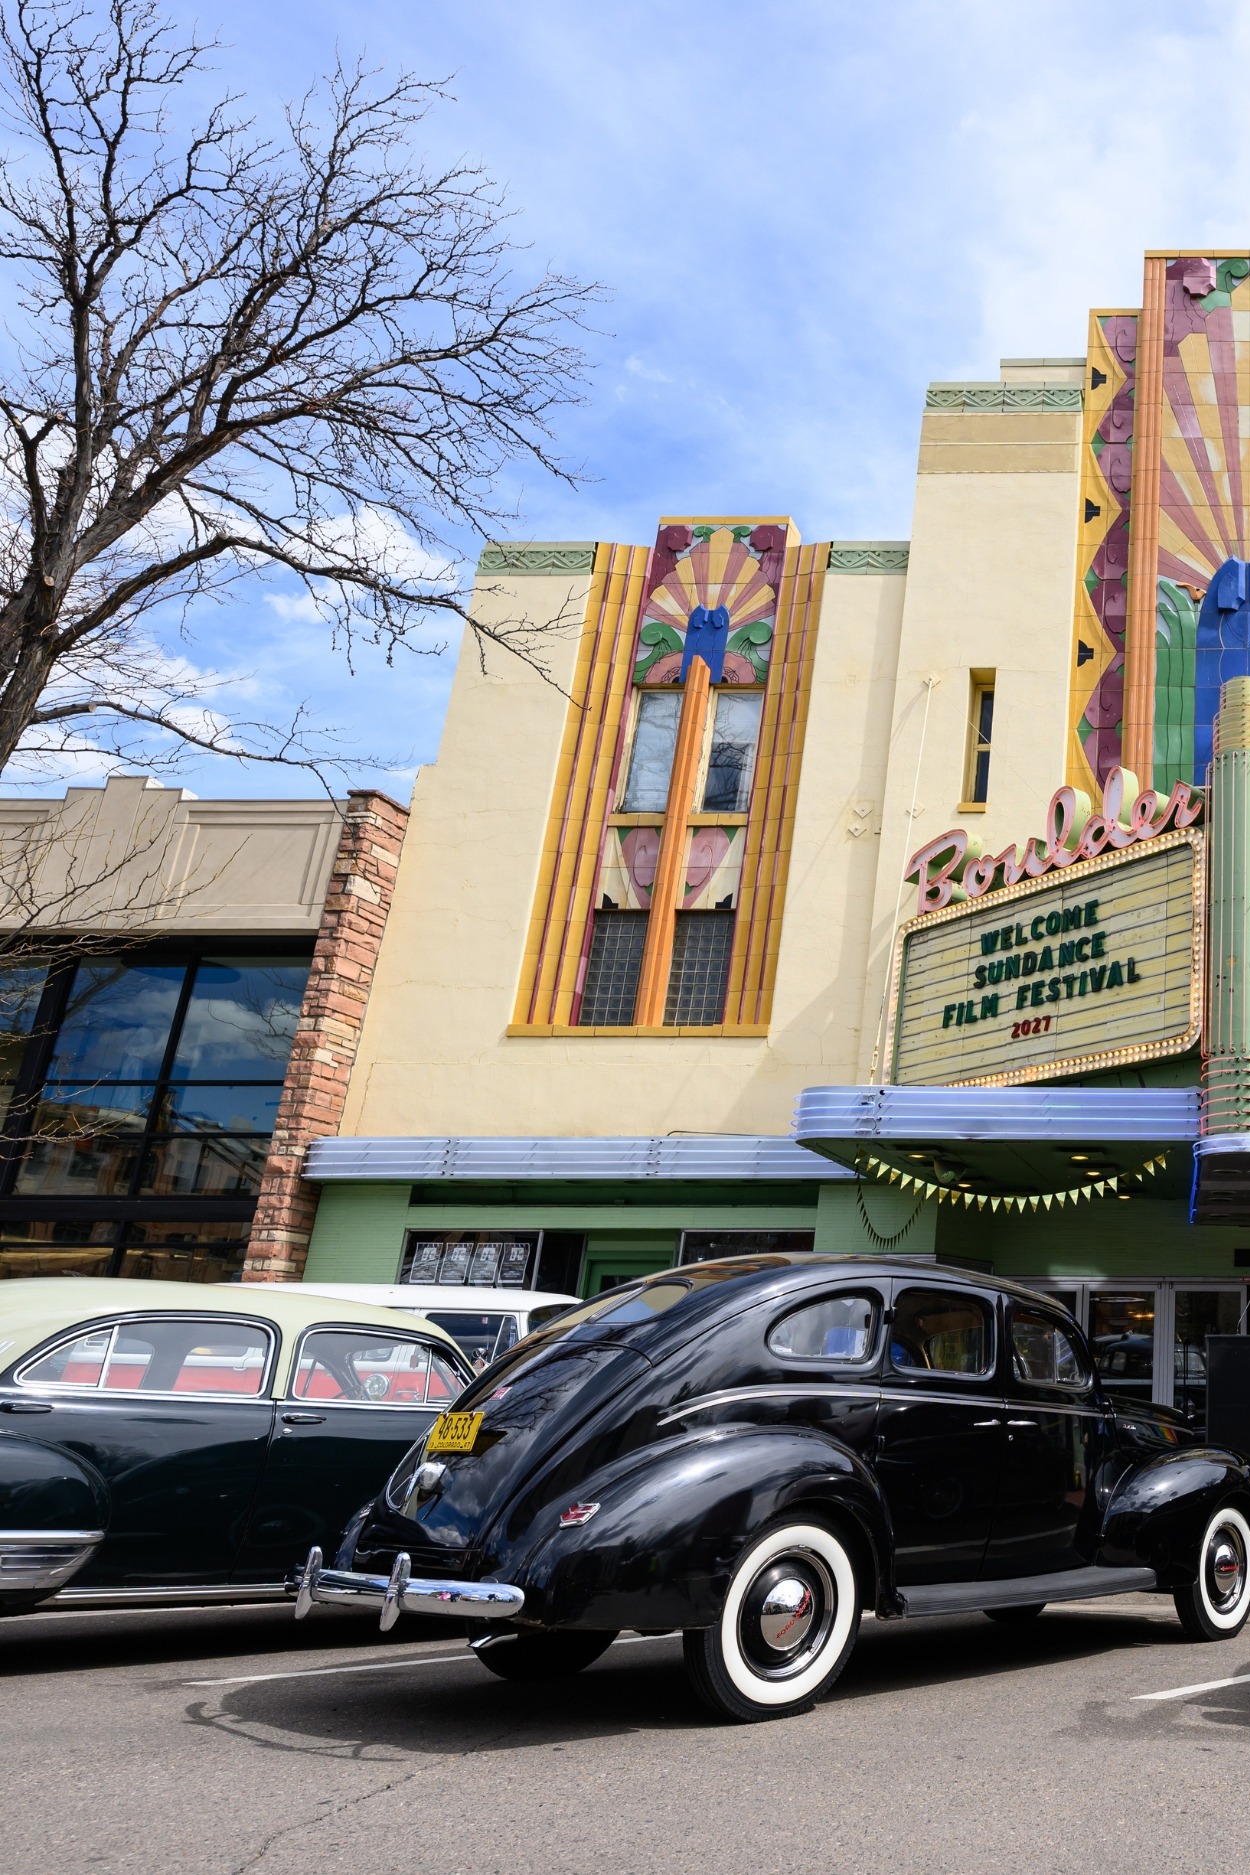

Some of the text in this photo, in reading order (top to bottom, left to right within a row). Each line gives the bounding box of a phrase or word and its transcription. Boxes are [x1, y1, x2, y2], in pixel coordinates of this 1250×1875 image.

[904, 765, 1205, 916] Boulder
[981, 899, 1099, 956] WELCOME
[973, 931, 1106, 989] SUNDANCE
[941, 957, 1141, 1029] FILM FESTIVAL
[1010, 1015, 1052, 1039] 2027
[775, 1619, 795, 1639] FORD
